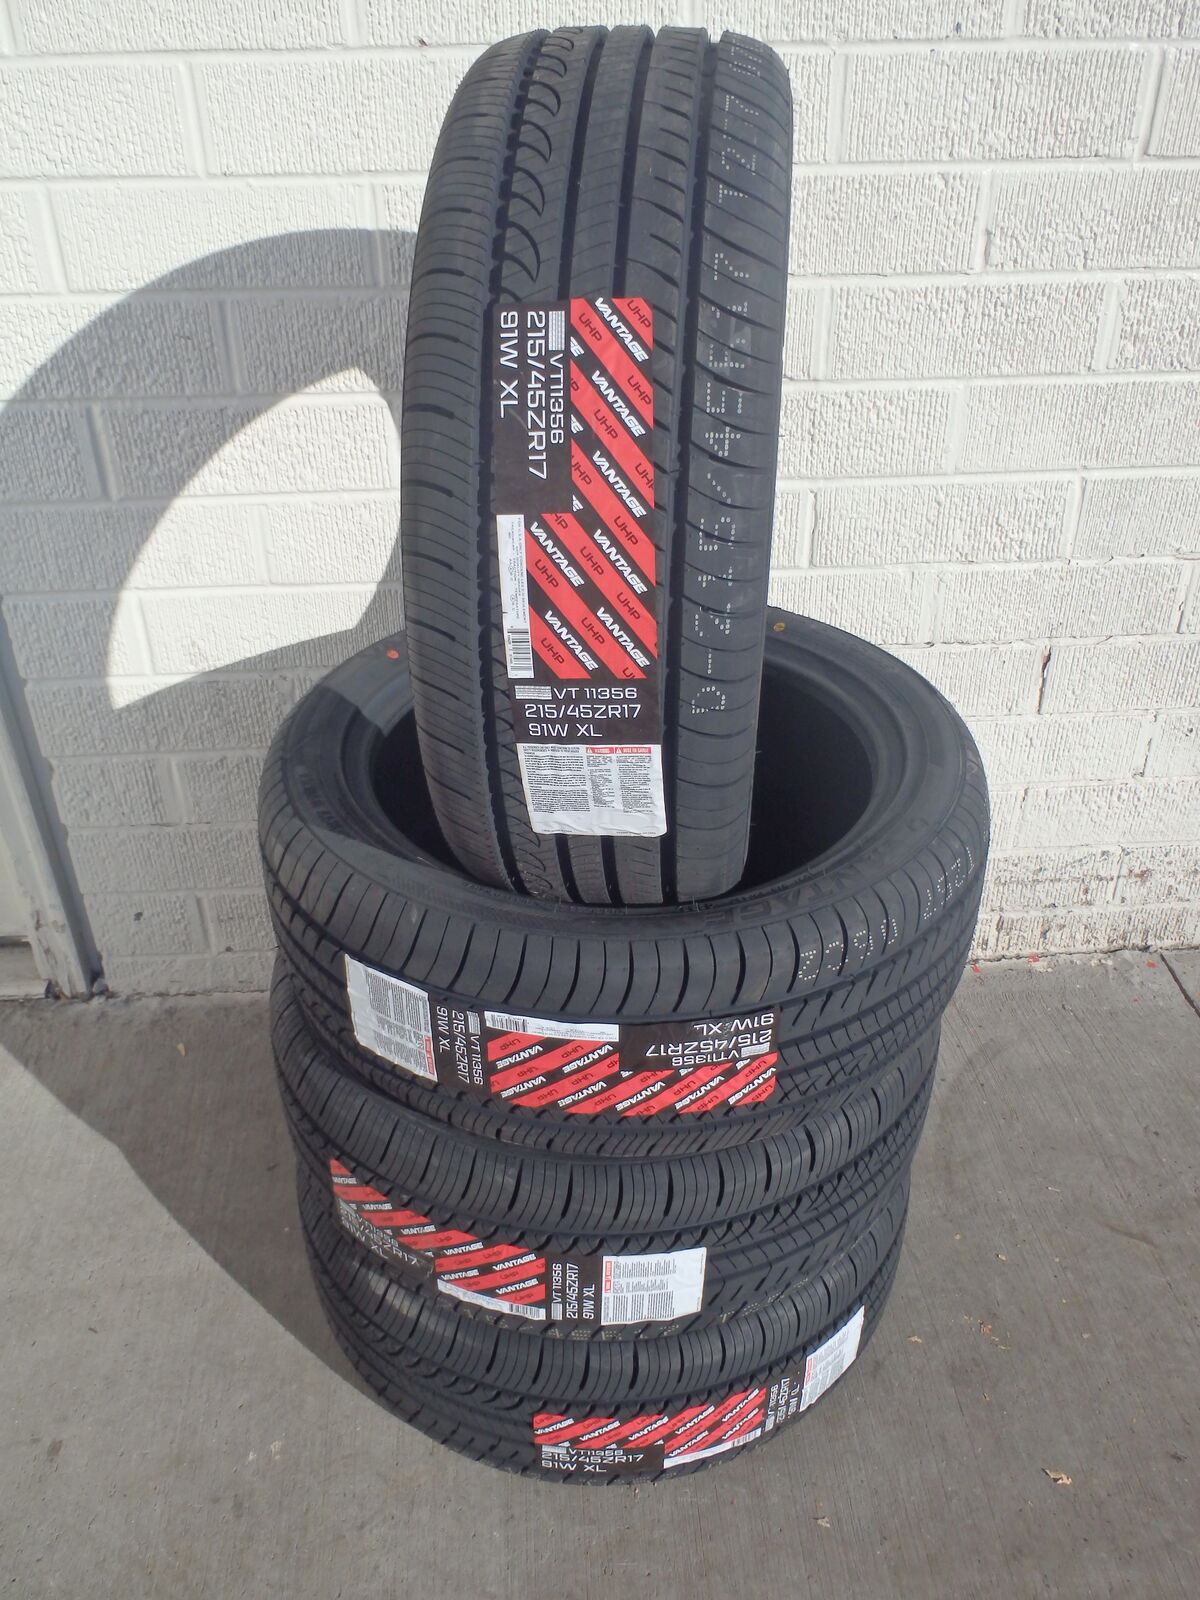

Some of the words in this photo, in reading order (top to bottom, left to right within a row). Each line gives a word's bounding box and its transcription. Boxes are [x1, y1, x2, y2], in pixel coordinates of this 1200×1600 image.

[578, 312, 603, 342] UHP
[627, 300, 651, 329] UHP
[500, 311, 519, 369] 91W
[595, 297, 649, 362] VANTAGE
[500, 379, 518, 419] XL
[527, 311, 547, 480] 215/45ZR17
[591, 369, 646, 437] VANTAGE
[627, 375, 651, 405] UHP
[593, 409, 618, 439] UHP
[592, 450, 647, 518] VANTAGE
[614, 515, 638, 546] UHP
[530, 521, 585, 587] VANTAGE
[580, 546, 604, 576] UHP
[593, 528, 648, 594] VANTAGE
[534, 559, 559, 588] UHP
[617, 592, 640, 620] UHP
[545, 610, 599, 671] VANTAGE
[581, 617, 605, 645] UHP
[597, 607, 650, 668] VANTAGE
[541, 638, 565, 664] UHP
[553, 687, 580, 700] VT
[584, 687, 637, 700] 11356
[524, 704, 641, 719] 215/45ZR17
[528, 723, 568, 737] 91W
[576, 724, 602, 737] XL
[437, 1006, 449, 1035] 91W
[694, 1022, 723, 1036] XL
[730, 1013, 775, 1032] 91W
[439, 1037, 450, 1053] XL
[453, 1010, 470, 1084] 215/45ZR17
[471, 1035, 480, 1051] VT
[500, 1038, 521, 1051] UHP
[561, 1045, 584, 1058] UHP
[645, 1028, 772, 1057] 215/45ZR17
[472, 1052, 483, 1085] 11356
[495, 1045, 543, 1069] VANTAGE
[562, 1044, 613, 1074] VANTAGE
[745, 1060, 767, 1077] UHP
[517, 1065, 538, 1078] UHP
[571, 1072, 594, 1086] UHP
[500, 1075, 546, 1098] VANTAGE
[537, 1088, 559, 1101] UHP
[557, 1081, 607, 1107] VANTAGE
[615, 1081, 666, 1112] VANTAGE
[673, 1080, 696, 1096] UHP
[675, 1075, 725, 1110] VANTAGE
[728, 1067, 776, 1105] VANTAGE
[443, 1241, 484, 1255] VANTAGE
[441, 1269, 479, 1280] VANTAGE
[492, 1253, 536, 1271] VANTAGE
[495, 1278, 539, 1294] VANTAGE
[553, 1263, 562, 1289] 11356
[553, 1290, 562, 1303] VT
[566, 1262, 579, 1319] 215/45ZR17
[583, 1284, 595, 1298] XL
[583, 1300, 595, 1320] 91W
[534, 1418, 574, 1434] VANTAGE
[579, 1421, 621, 1441] VANTAGE
[628, 1415, 669, 1441] VANTAGE
[583, 1464, 607, 1472] XL
